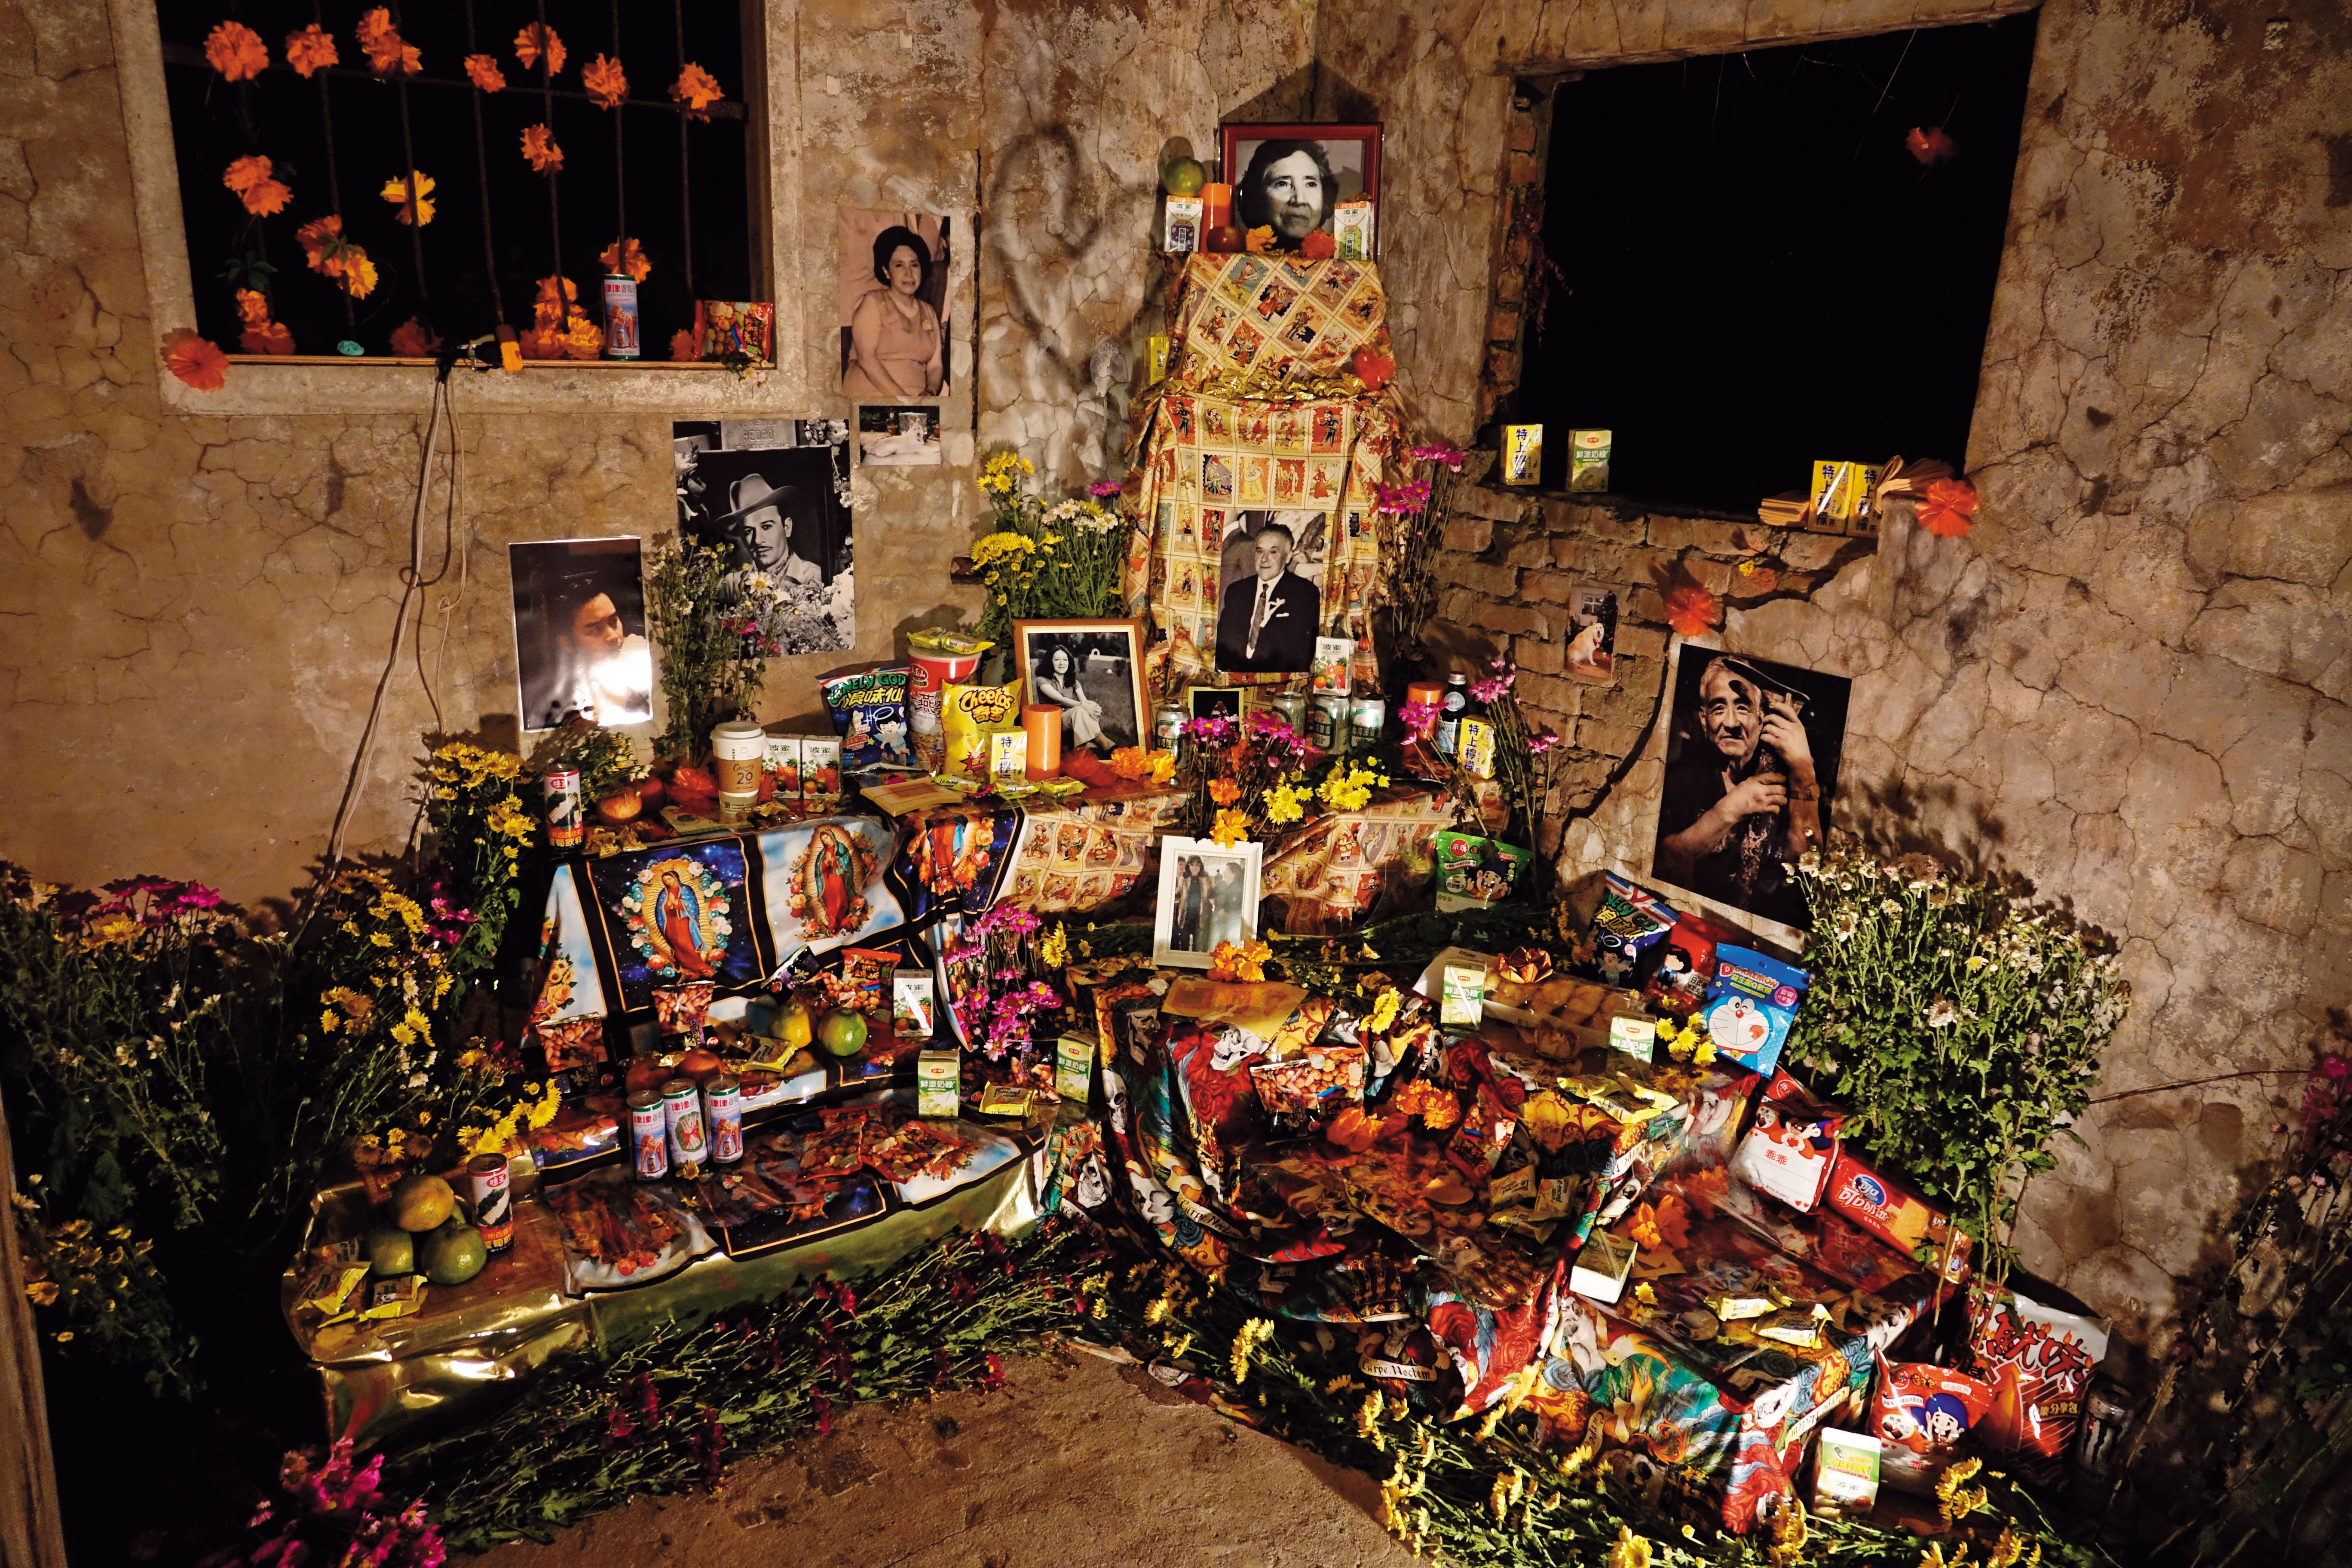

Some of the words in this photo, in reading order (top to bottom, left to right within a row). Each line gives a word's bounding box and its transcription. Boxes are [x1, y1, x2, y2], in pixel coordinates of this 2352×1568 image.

[744, 429, 774, 441] PEDRO
[878, 674, 906, 686] GOD
[841, 687, 905, 709] 浪味仙
[959, 687, 1014, 712] Cheetos
[972, 704, 1005, 724] 奇多
[737, 772, 753, 784] 20
[1719, 962, 1780, 990] DORAEMON
[1764, 1148, 1788, 1166] 乖乖
[1837, 1185, 1890, 1222] 可口奶滋
[1362, 1357, 1387, 1375] Carpe
[1390, 1365, 1431, 1380] Noctem
